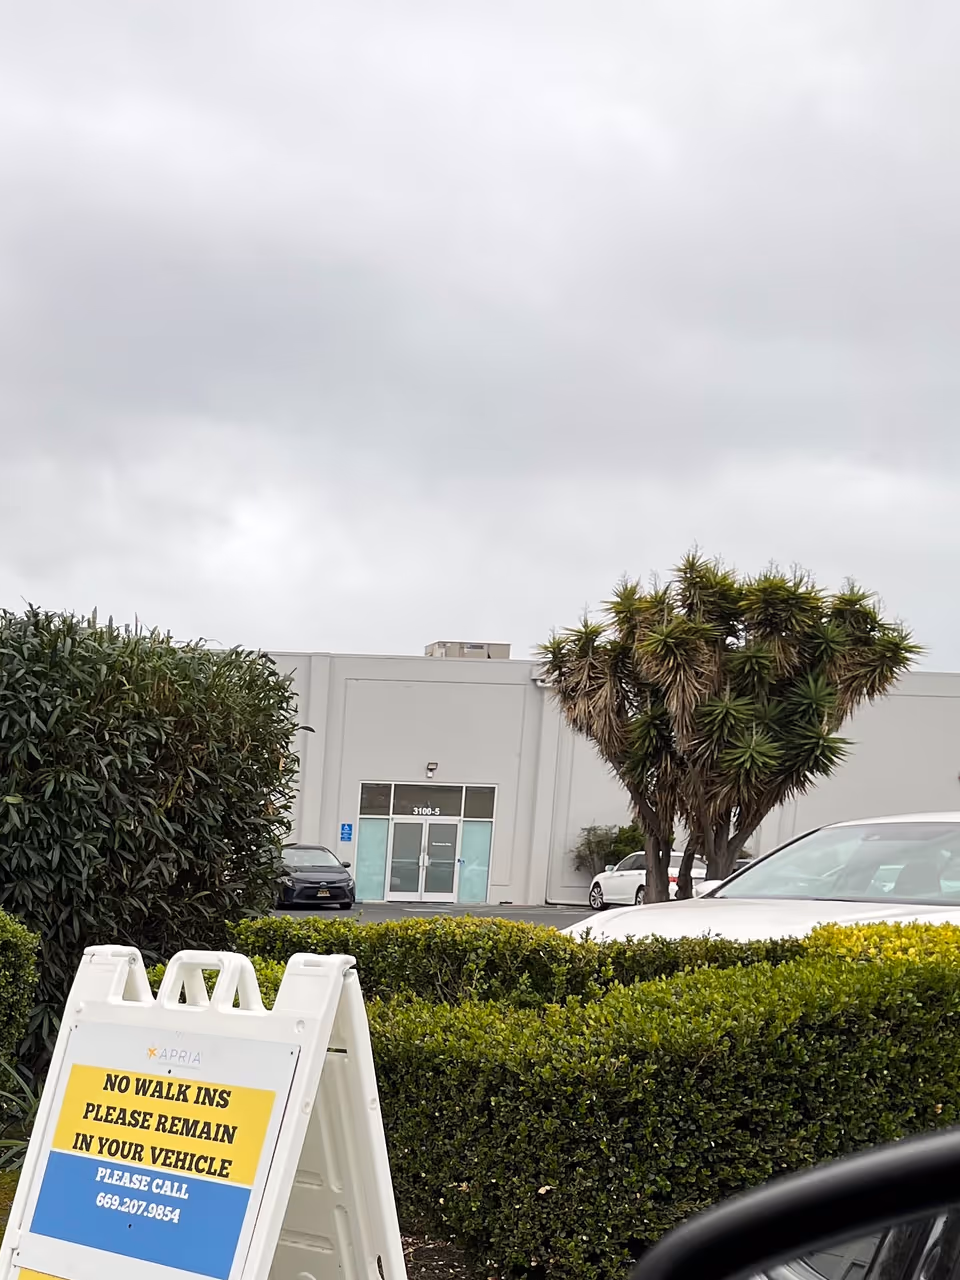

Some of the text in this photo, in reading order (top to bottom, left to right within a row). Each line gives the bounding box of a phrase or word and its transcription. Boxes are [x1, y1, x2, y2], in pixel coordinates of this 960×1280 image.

[412, 807, 440, 815] 3100-5
[158, 1048, 201, 1064] APRIA
[103, 1073, 232, 1109] NO WALK INS
[82, 1102, 238, 1144] PLEASE REMAIN
[72, 1132, 233, 1179] IN YOUR VEHICLE
[95, 1166, 189, 1200] PLEASE CALL
[95, 1192, 181, 1224] 669.207.9854
